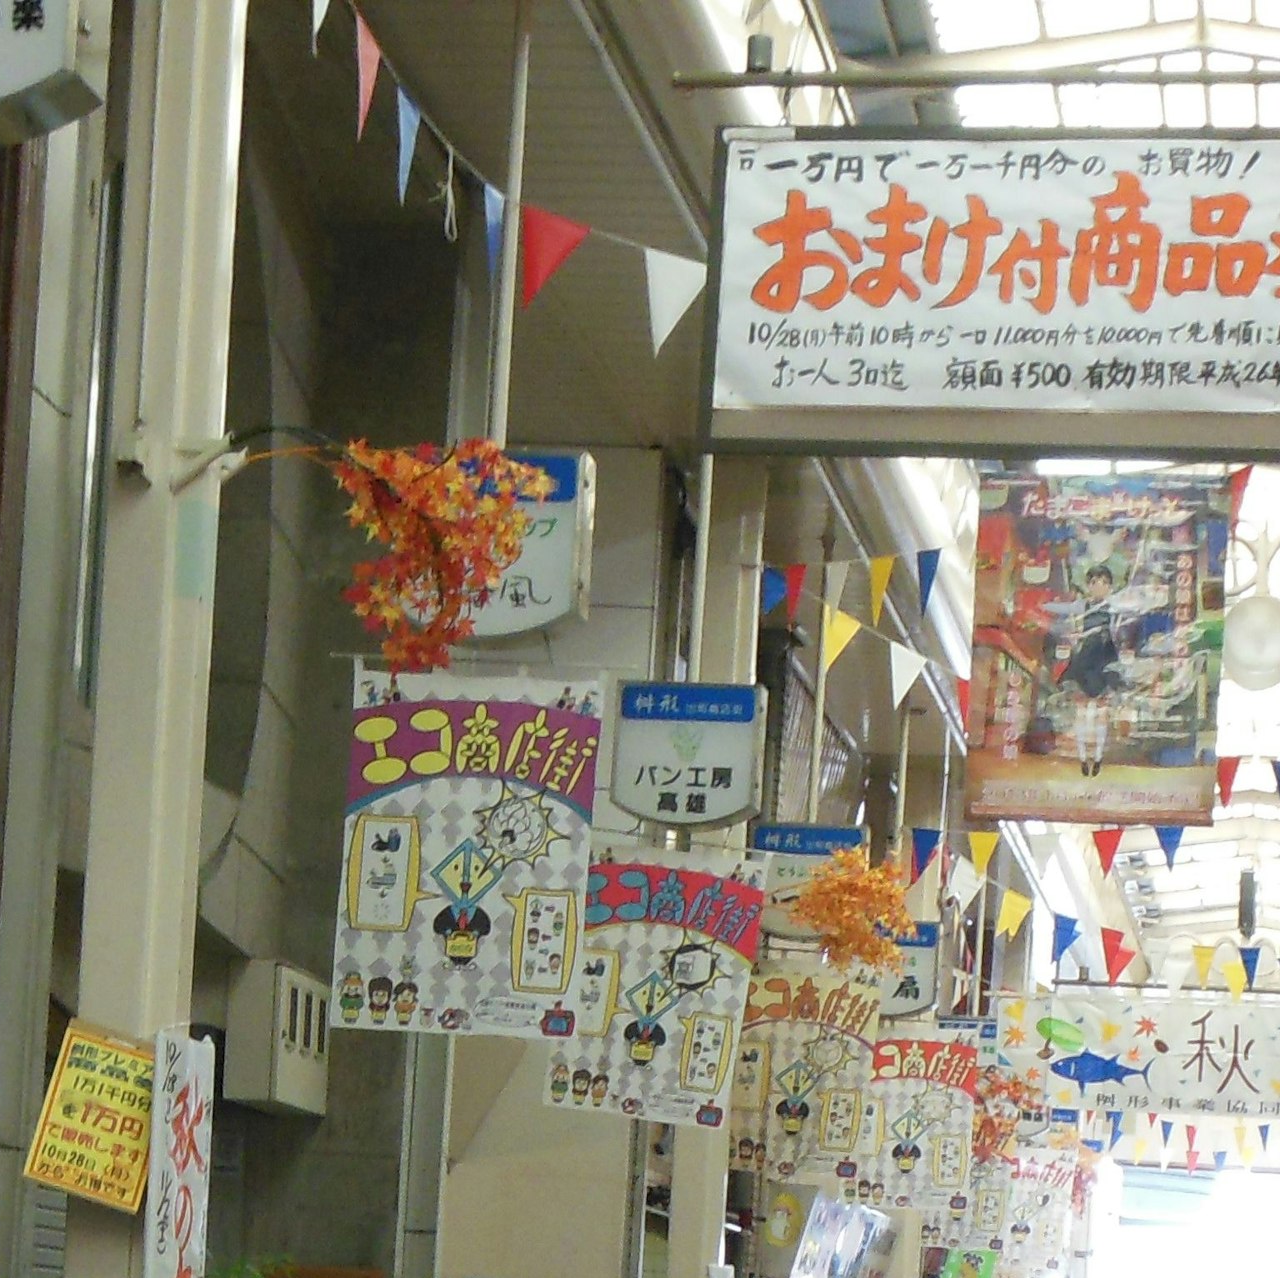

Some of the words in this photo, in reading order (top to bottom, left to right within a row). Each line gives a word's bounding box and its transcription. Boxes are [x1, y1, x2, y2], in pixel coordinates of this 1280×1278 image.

[353, 702, 598, 797] エコ商店街
[634, 765, 733, 790] パン工房
[585, 867, 761, 948] エコ商店街
[870, 1040, 977, 1087] コ商店街
[1181, 1009, 1261, 1095] 秋
